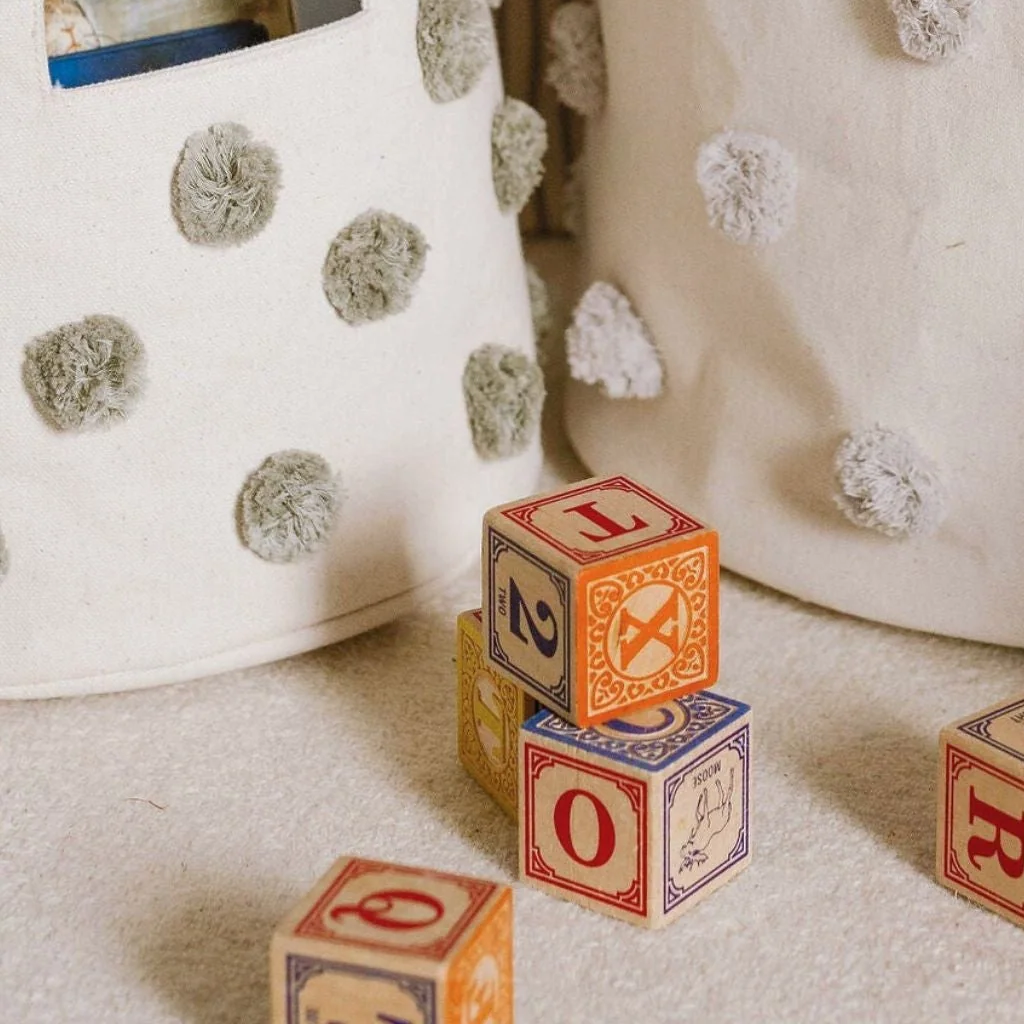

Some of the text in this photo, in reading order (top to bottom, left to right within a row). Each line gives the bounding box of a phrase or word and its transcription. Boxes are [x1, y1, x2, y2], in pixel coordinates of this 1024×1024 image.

[563, 501, 650, 543] T
[509, 576, 558, 658] 2
[619, 587, 680, 671] X
[554, 789, 616, 868] O
[330, 889, 445, 932] Q
